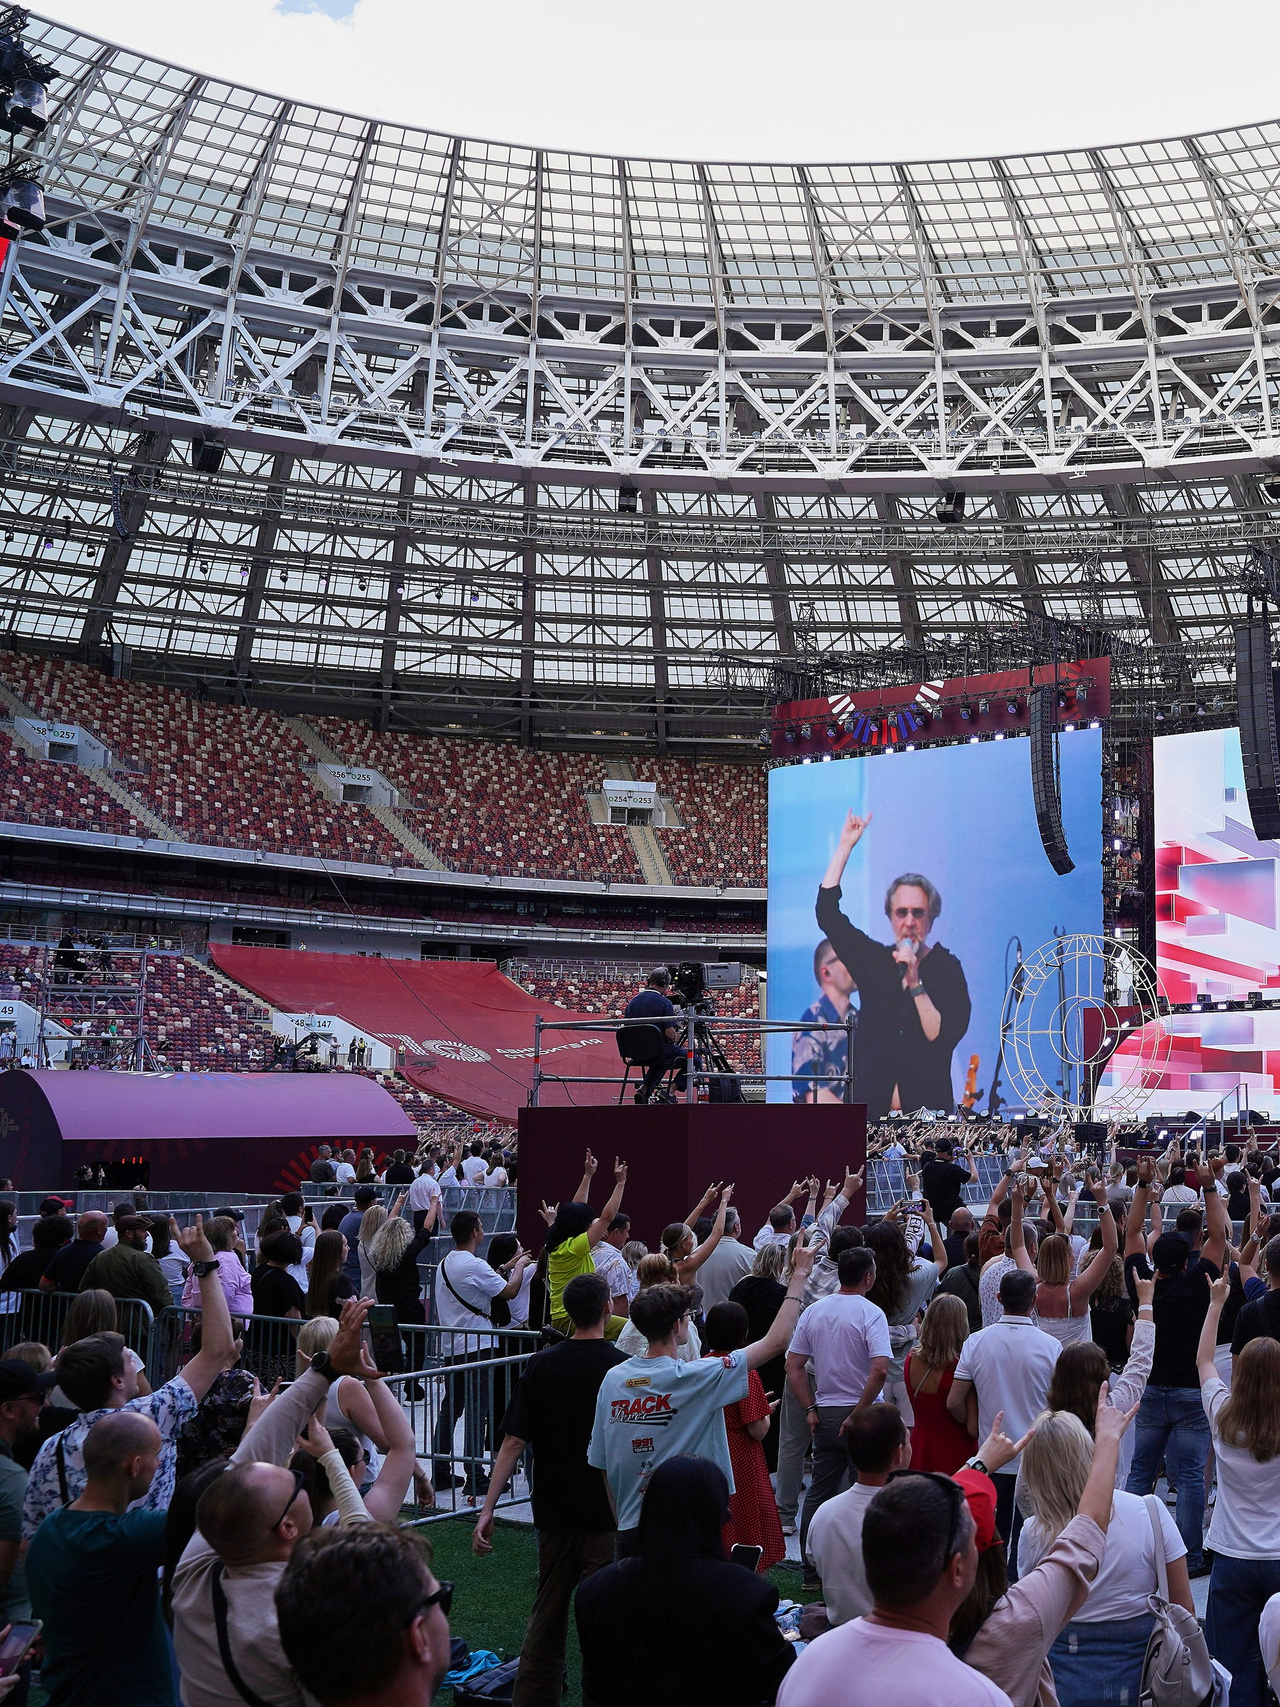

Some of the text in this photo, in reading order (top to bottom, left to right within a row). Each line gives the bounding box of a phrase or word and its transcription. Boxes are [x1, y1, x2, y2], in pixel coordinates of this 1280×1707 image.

[60, 731, 76, 740] 257
[356, 774, 371, 782] 255
[317, 1020, 332, 1028] 147
[610, 1393, 672, 1417] TRACK
[631, 1437, 654, 1448] 1991
